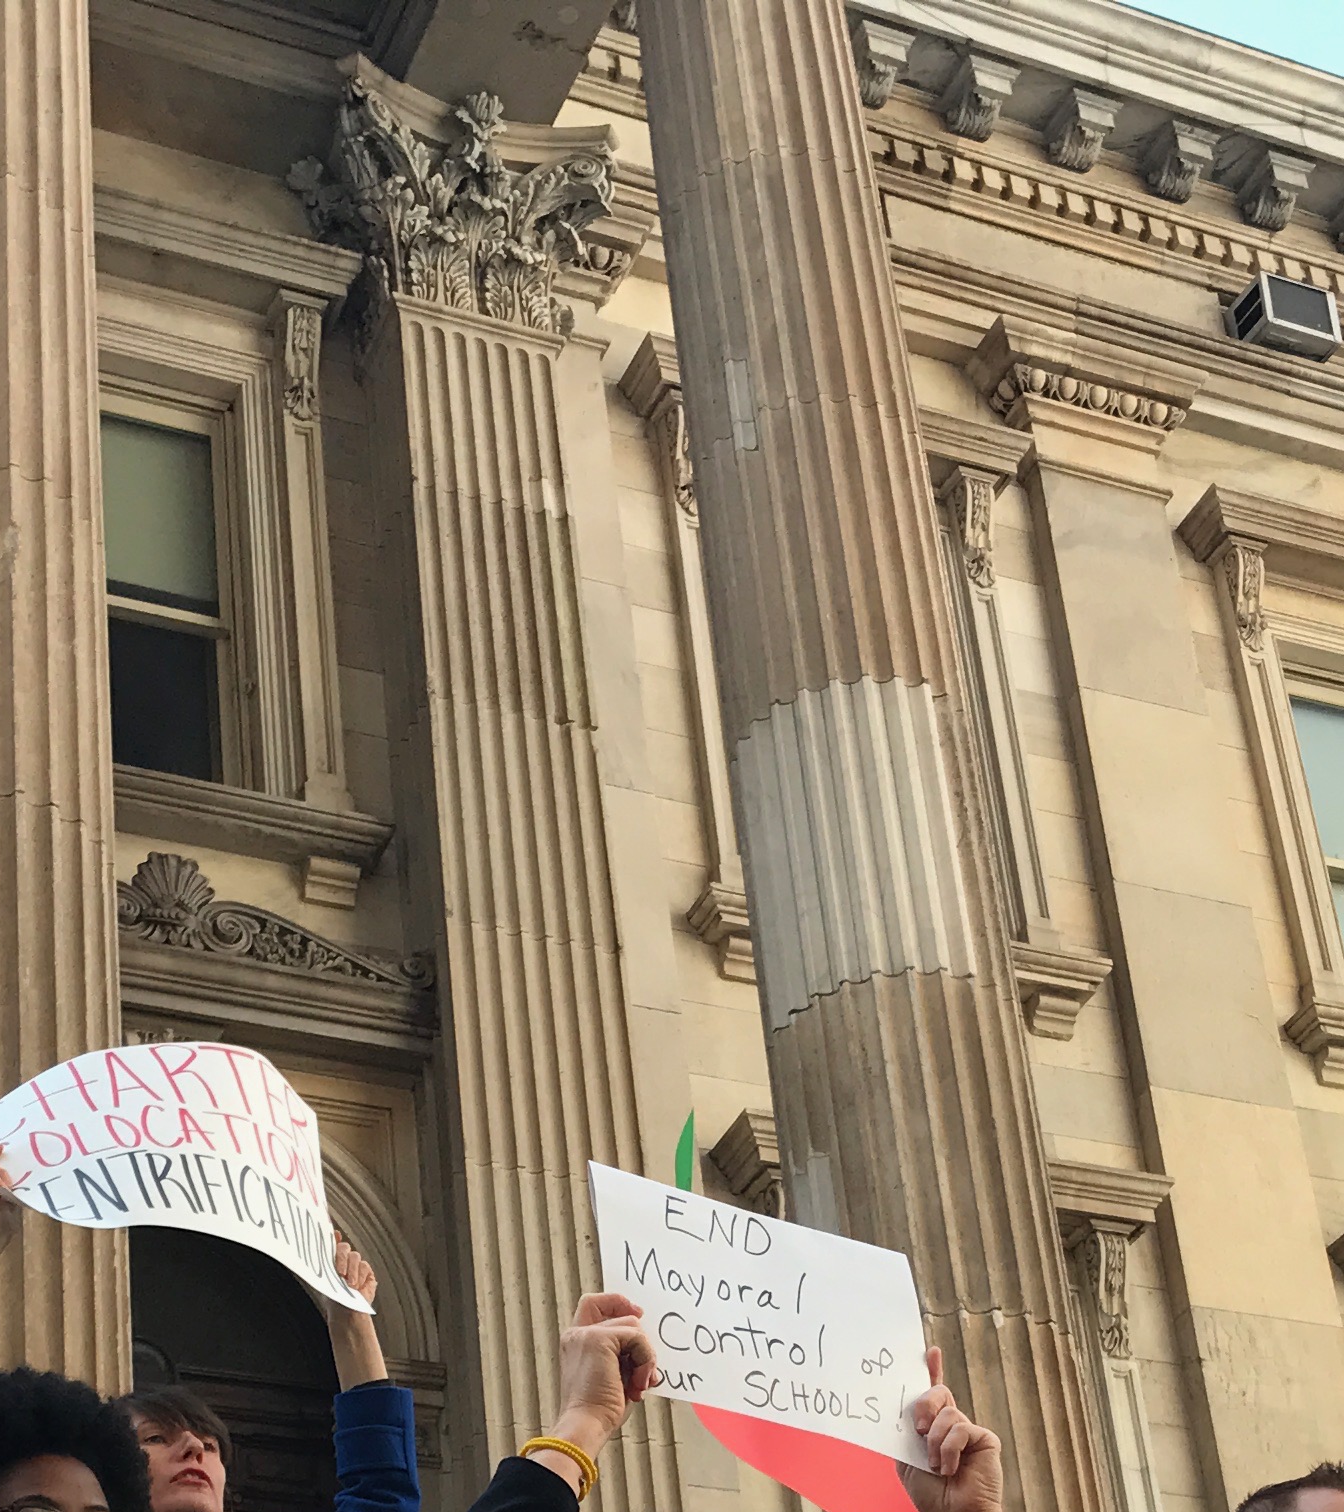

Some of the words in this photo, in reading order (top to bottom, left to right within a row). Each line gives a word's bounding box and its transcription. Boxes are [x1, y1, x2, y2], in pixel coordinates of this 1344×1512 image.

[0, 1105, 319, 1207] OLOCATION
[11, 1150, 356, 1299] ENTRIFICATION
[664, 1194, 772, 1256] END
[624, 1240, 807, 1314] Mayoral
[658, 1311, 826, 1367] Control
